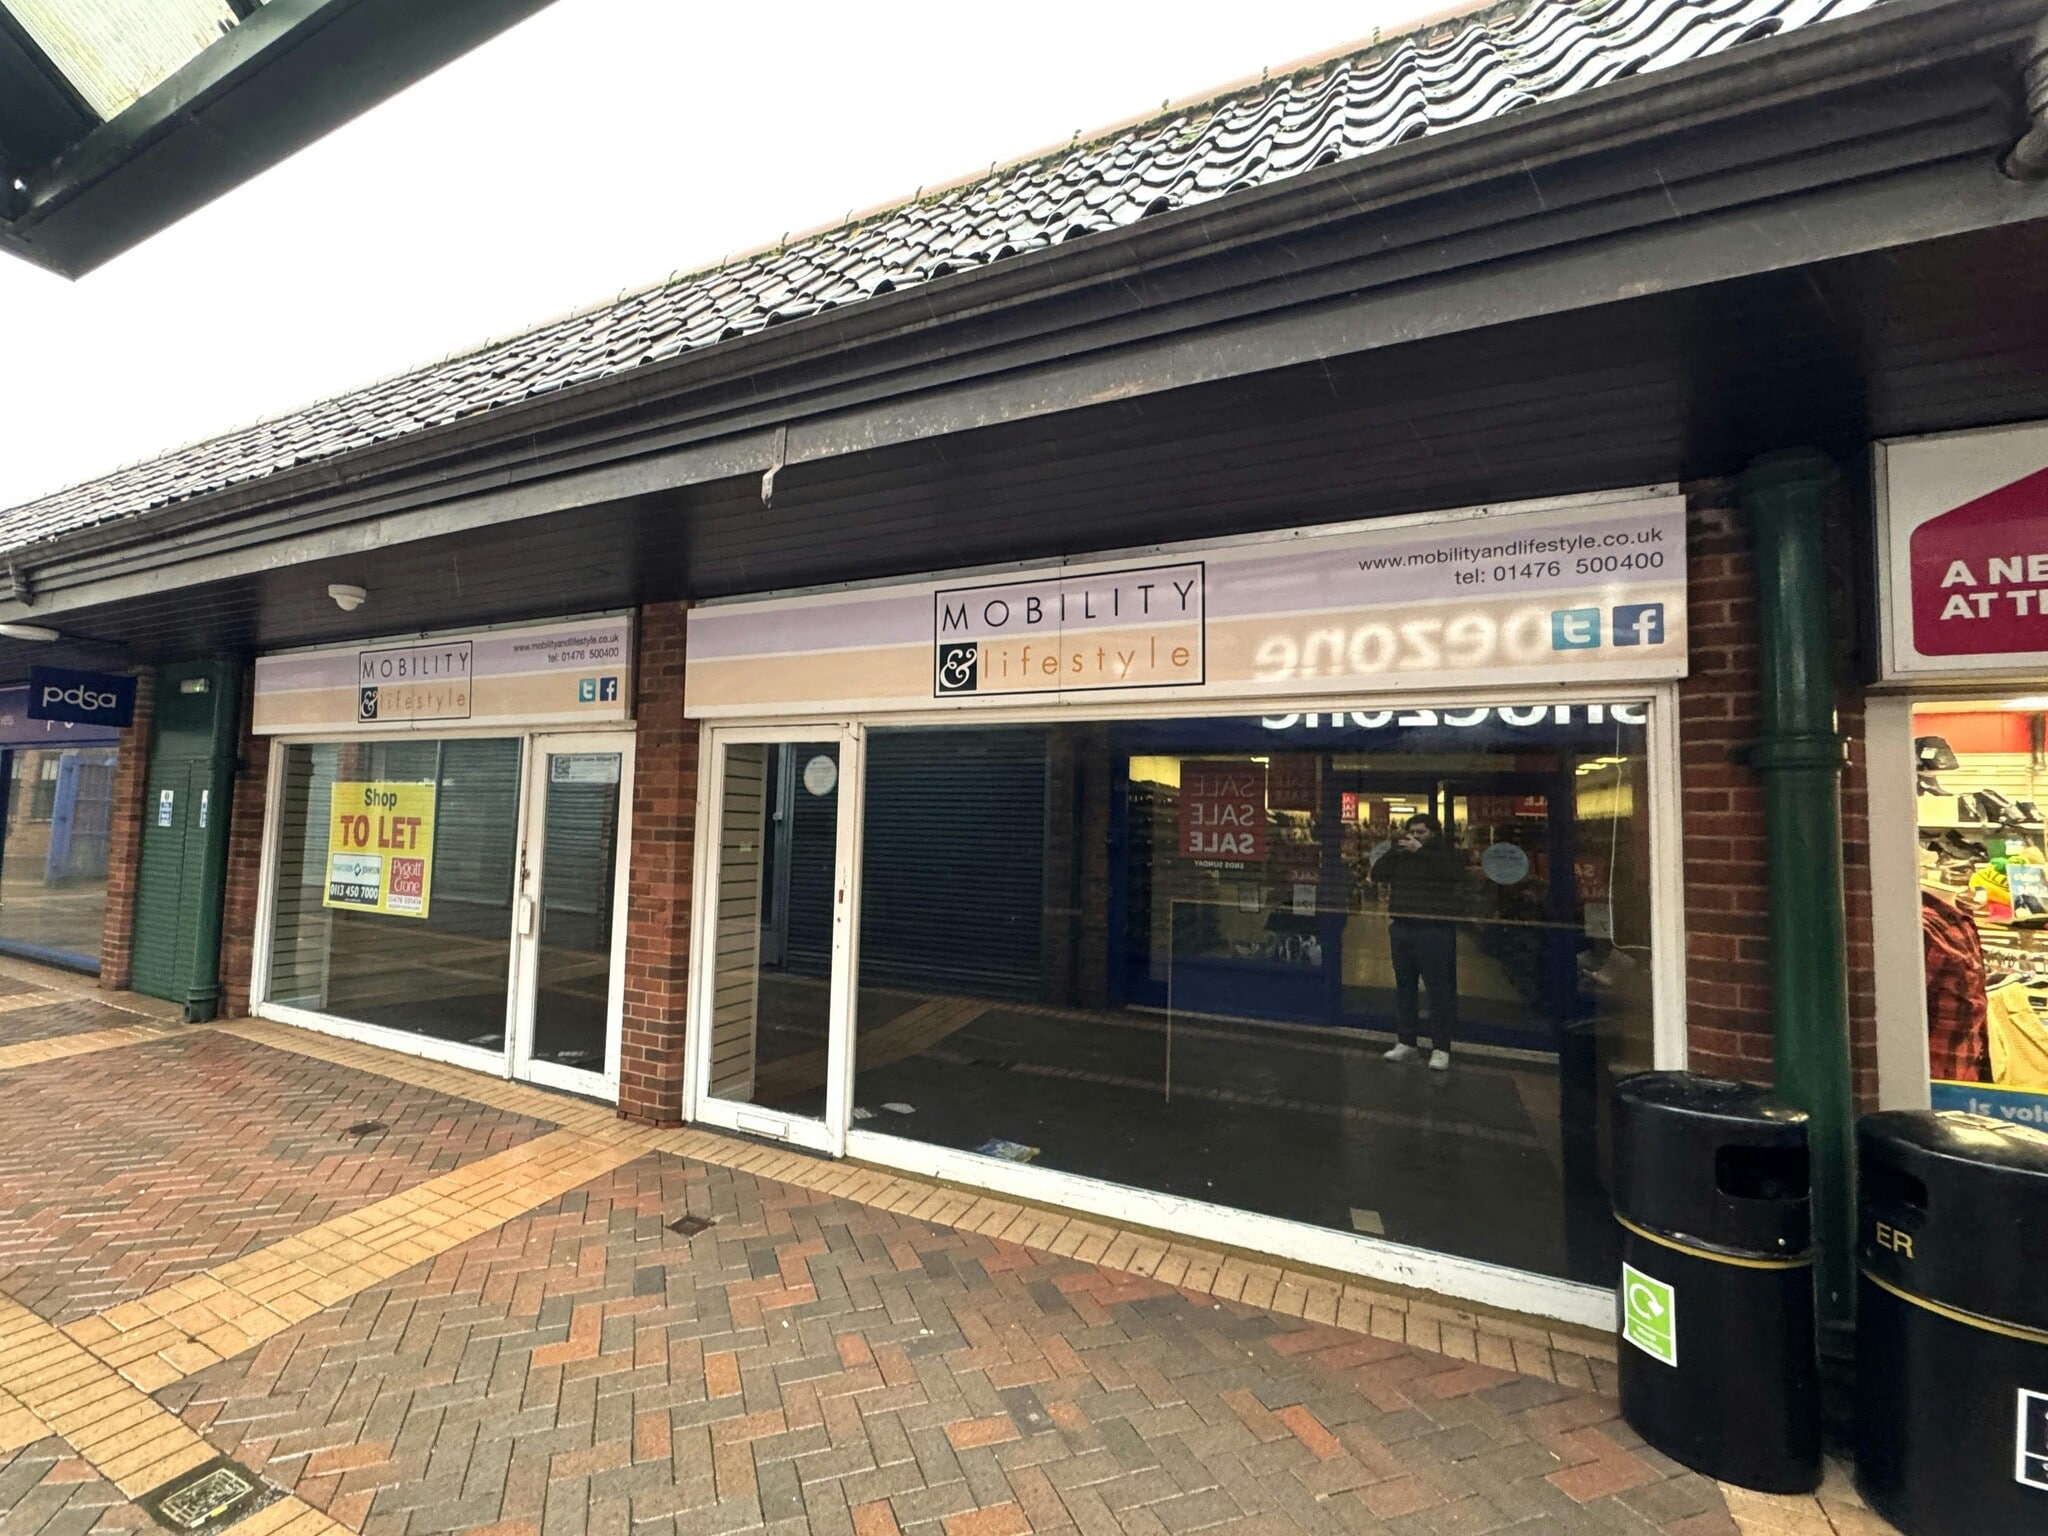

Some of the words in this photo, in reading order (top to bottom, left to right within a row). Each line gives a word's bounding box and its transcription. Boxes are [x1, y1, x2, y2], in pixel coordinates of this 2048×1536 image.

[1358, 527, 1664, 571] www.mobilityandlifestyle.co.uk
[1454, 568, 1486, 585] tel:
[1493, 561, 1561, 582] 01476
[1576, 551, 1664, 575] 500400
[1940, 559, 1978, 588] A
[1988, 553, 2048, 585] NE
[942, 580, 1194, 632] MOBILITY
[1940, 592, 1999, 620] AT
[513, 633, 619, 652] www.mobilityandlifestyle.co.uk
[548, 652, 560, 663] tel:
[561, 650, 585, 662] 01476
[589, 647, 619, 659] 500400
[362, 652, 468, 679] MOBILITY
[984, 636, 1190, 679] lifestyle
[42, 684, 117, 710] pdsa
[379, 687, 466, 711] lifestyle
[364, 787, 397, 811] Shop
[340, 814, 370, 848] TO
[378, 815, 422, 850] LET
[392, 859, 422, 879] Pygott
[329, 883, 344, 896] 0113
[345, 885, 359, 898] 450
[360, 886, 378, 899] 7000
[393, 879, 421, 894] Crone
